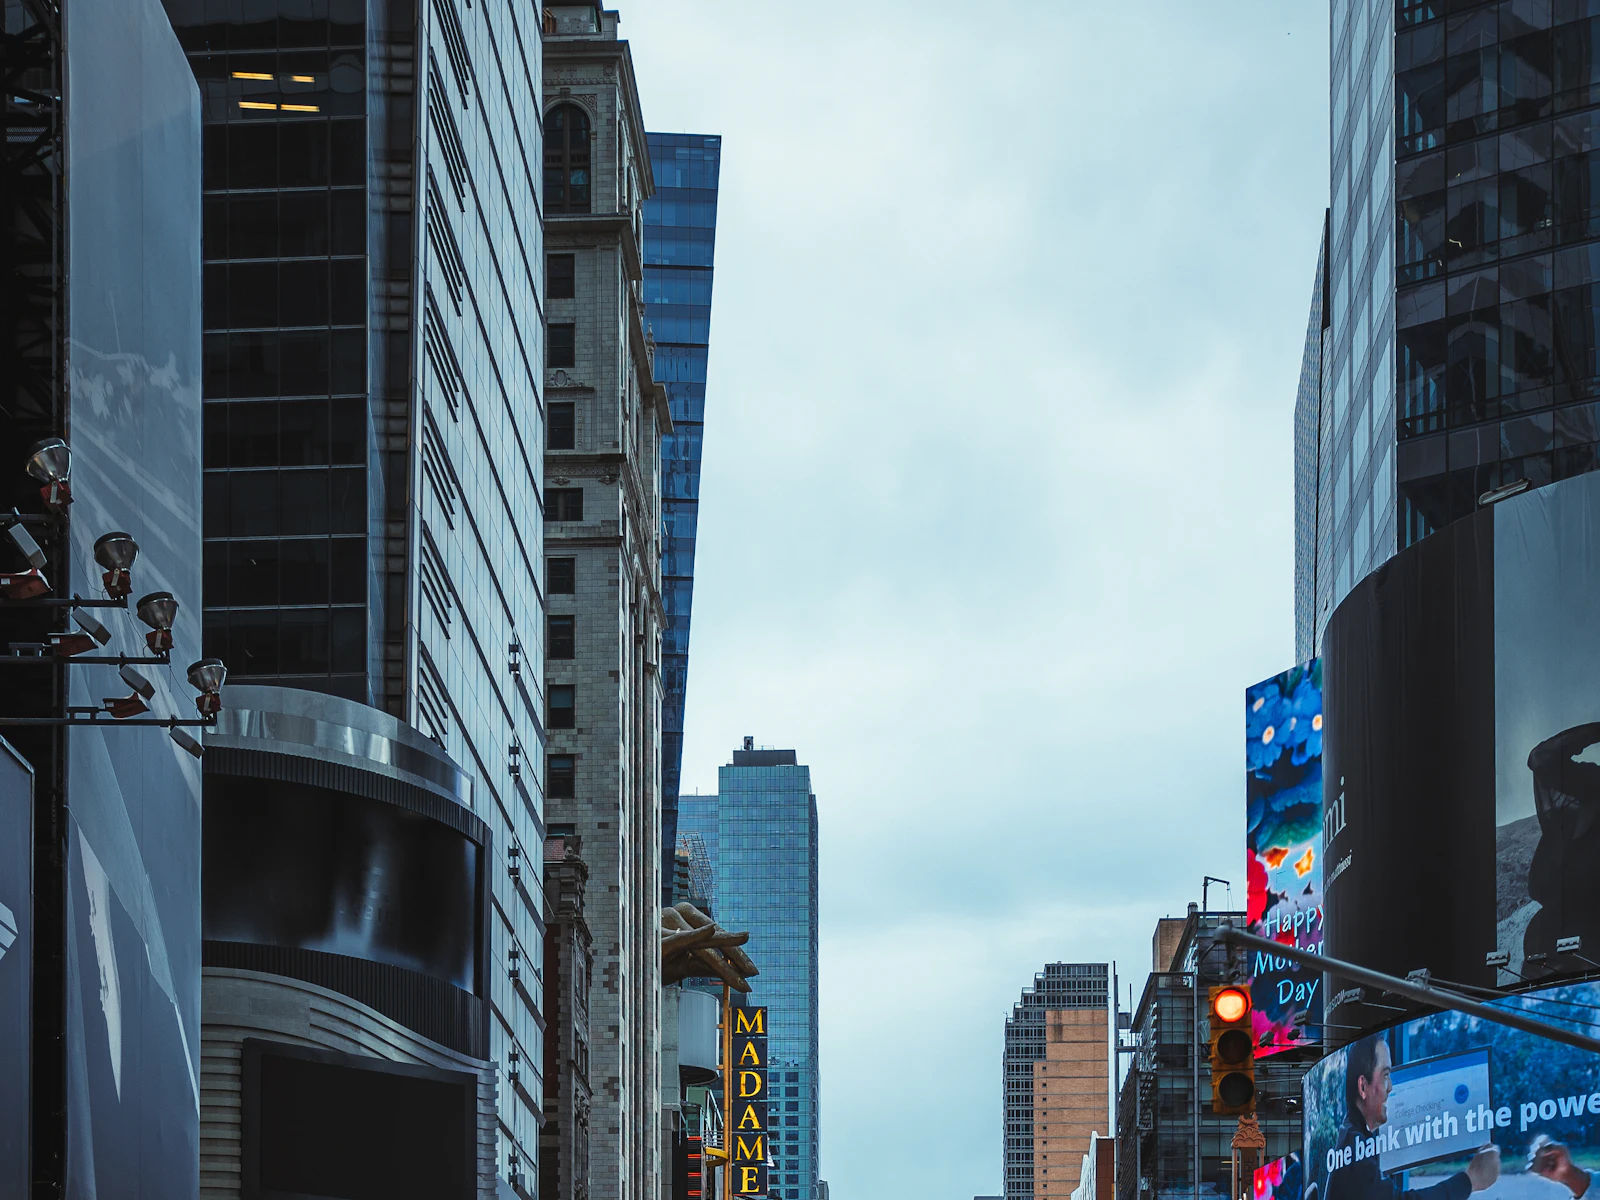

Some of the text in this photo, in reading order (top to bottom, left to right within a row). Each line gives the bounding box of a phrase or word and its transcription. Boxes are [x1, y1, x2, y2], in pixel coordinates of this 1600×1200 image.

[1264, 904, 1324, 937] Happy
[1276, 978, 1320, 1009] Day
[735, 1007, 765, 1193] MADAME
[1326, 1146, 1353, 1173] One
[1354, 1125, 1401, 1163] bank
[1404, 1105, 1459, 1147] with
[1464, 1103, 1513, 1134] the
